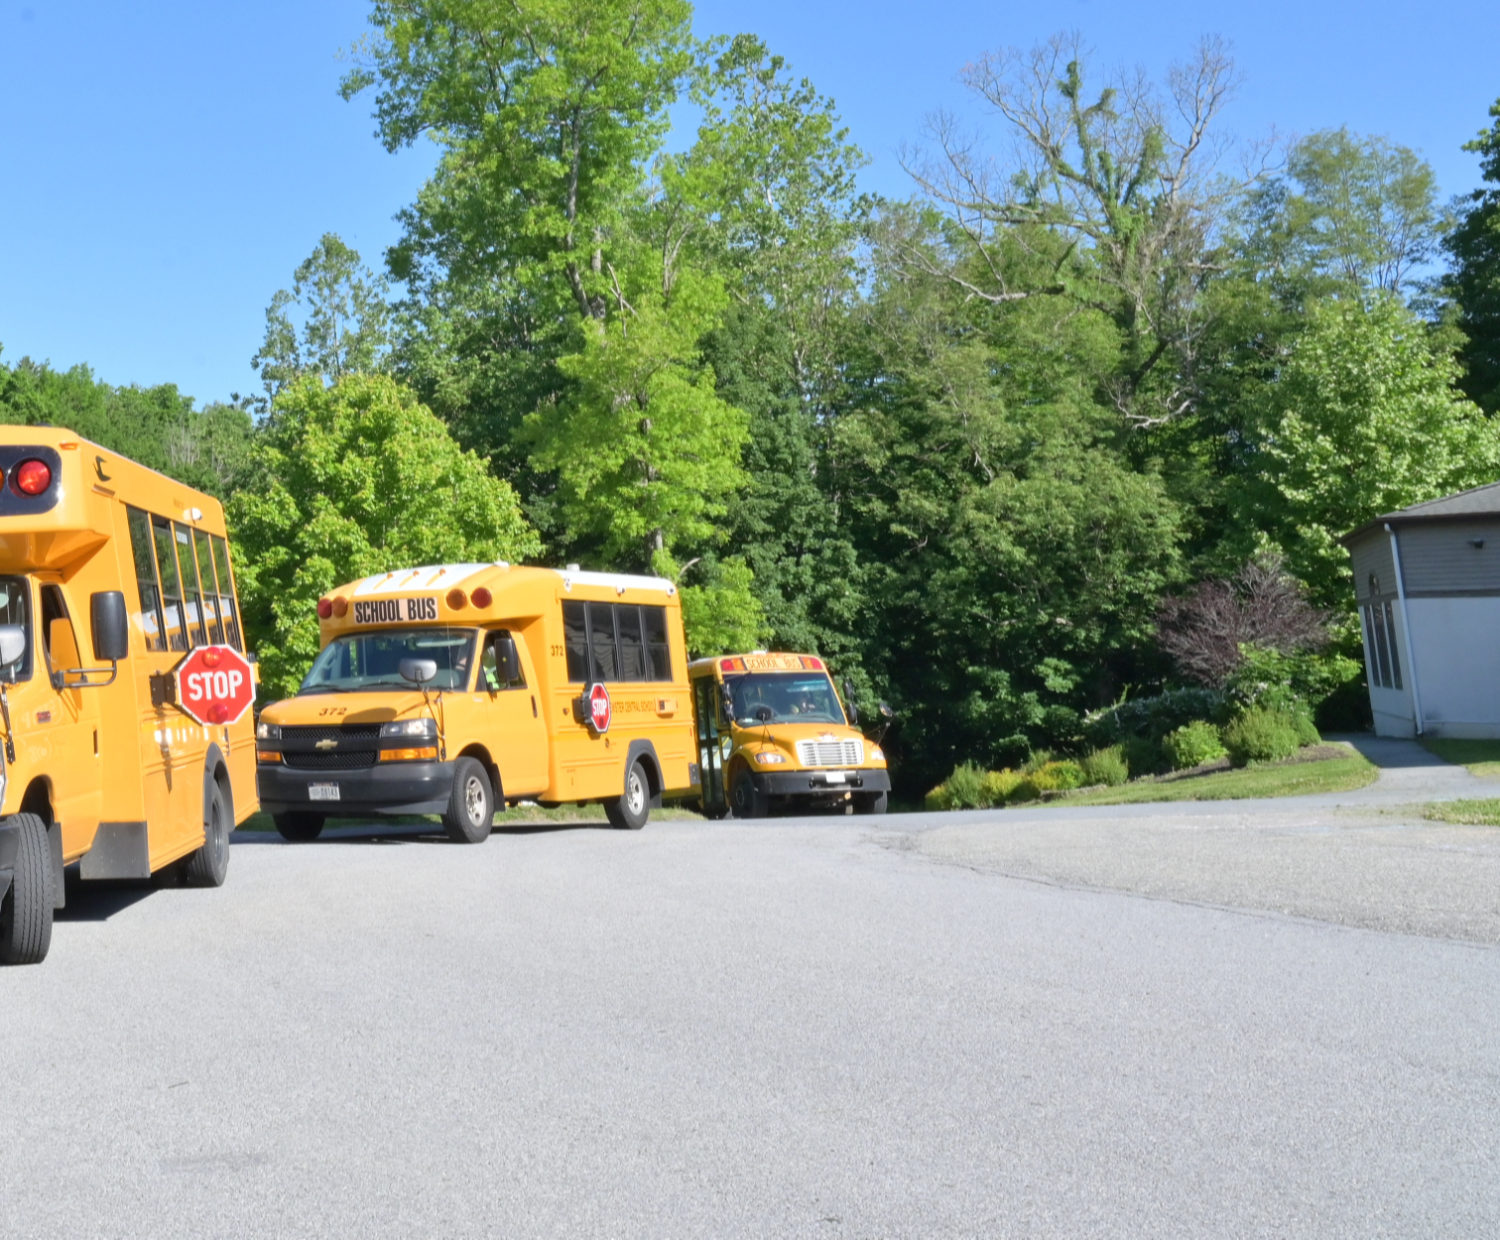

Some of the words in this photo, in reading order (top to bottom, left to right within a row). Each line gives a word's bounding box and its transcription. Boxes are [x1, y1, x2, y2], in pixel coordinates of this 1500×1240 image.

[355, 600, 403, 623] SCHOOL
[407, 597, 436, 621] BUS
[551, 645, 564, 656] 372
[746, 658, 778, 669] SCHOOL
[783, 657, 801, 669] BUS
[187, 669, 243, 701] STOP
[319, 707, 347, 716] 372
[592, 698, 607, 716] STOP
